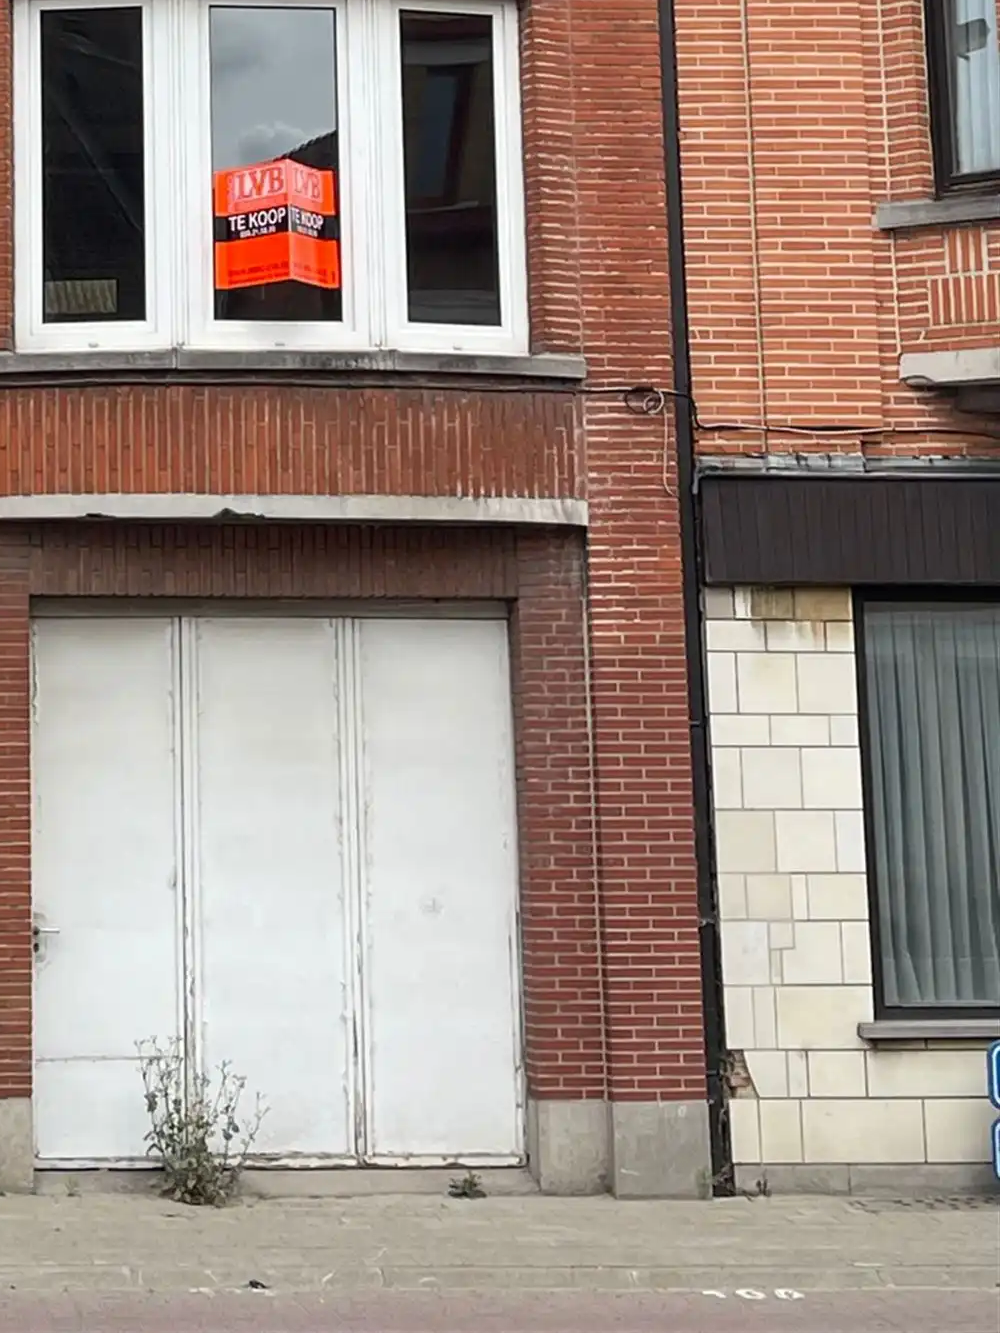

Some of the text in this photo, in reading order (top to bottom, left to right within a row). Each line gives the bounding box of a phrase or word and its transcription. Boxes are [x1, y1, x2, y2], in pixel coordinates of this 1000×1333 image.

[236, 167, 284, 199] LVB
[228, 207, 286, 232] TE KOOP
[301, 210, 324, 230] KOOP
